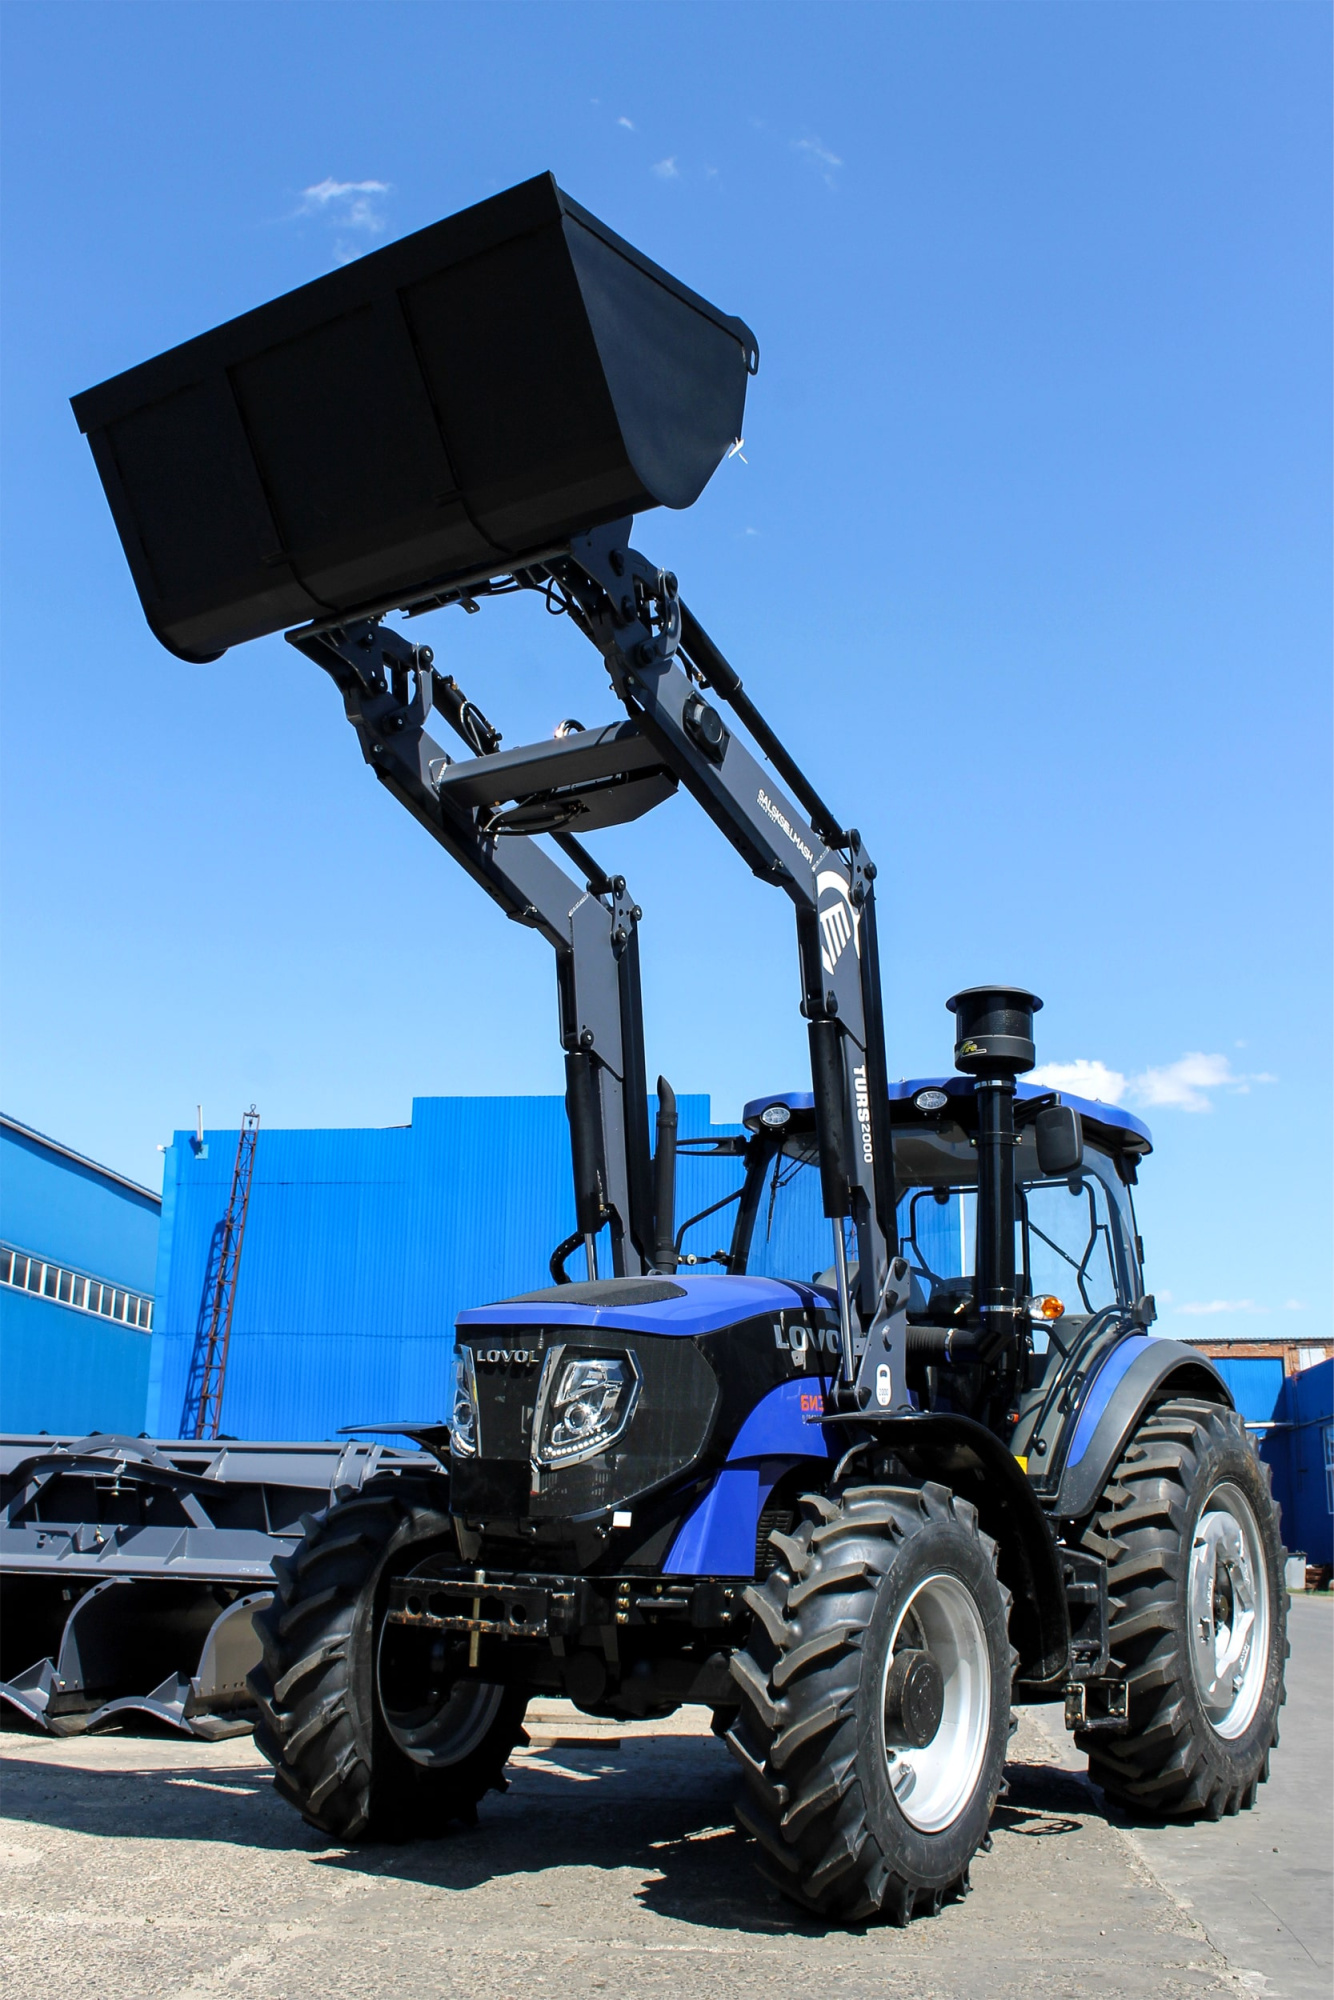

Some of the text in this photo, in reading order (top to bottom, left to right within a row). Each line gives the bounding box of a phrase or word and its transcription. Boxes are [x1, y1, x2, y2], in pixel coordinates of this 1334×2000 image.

[758, 789, 813, 864] SALSKSELMASH
[773, 1324, 840, 1354] LOVO
[476, 1350, 540, 1363] LOVOL
